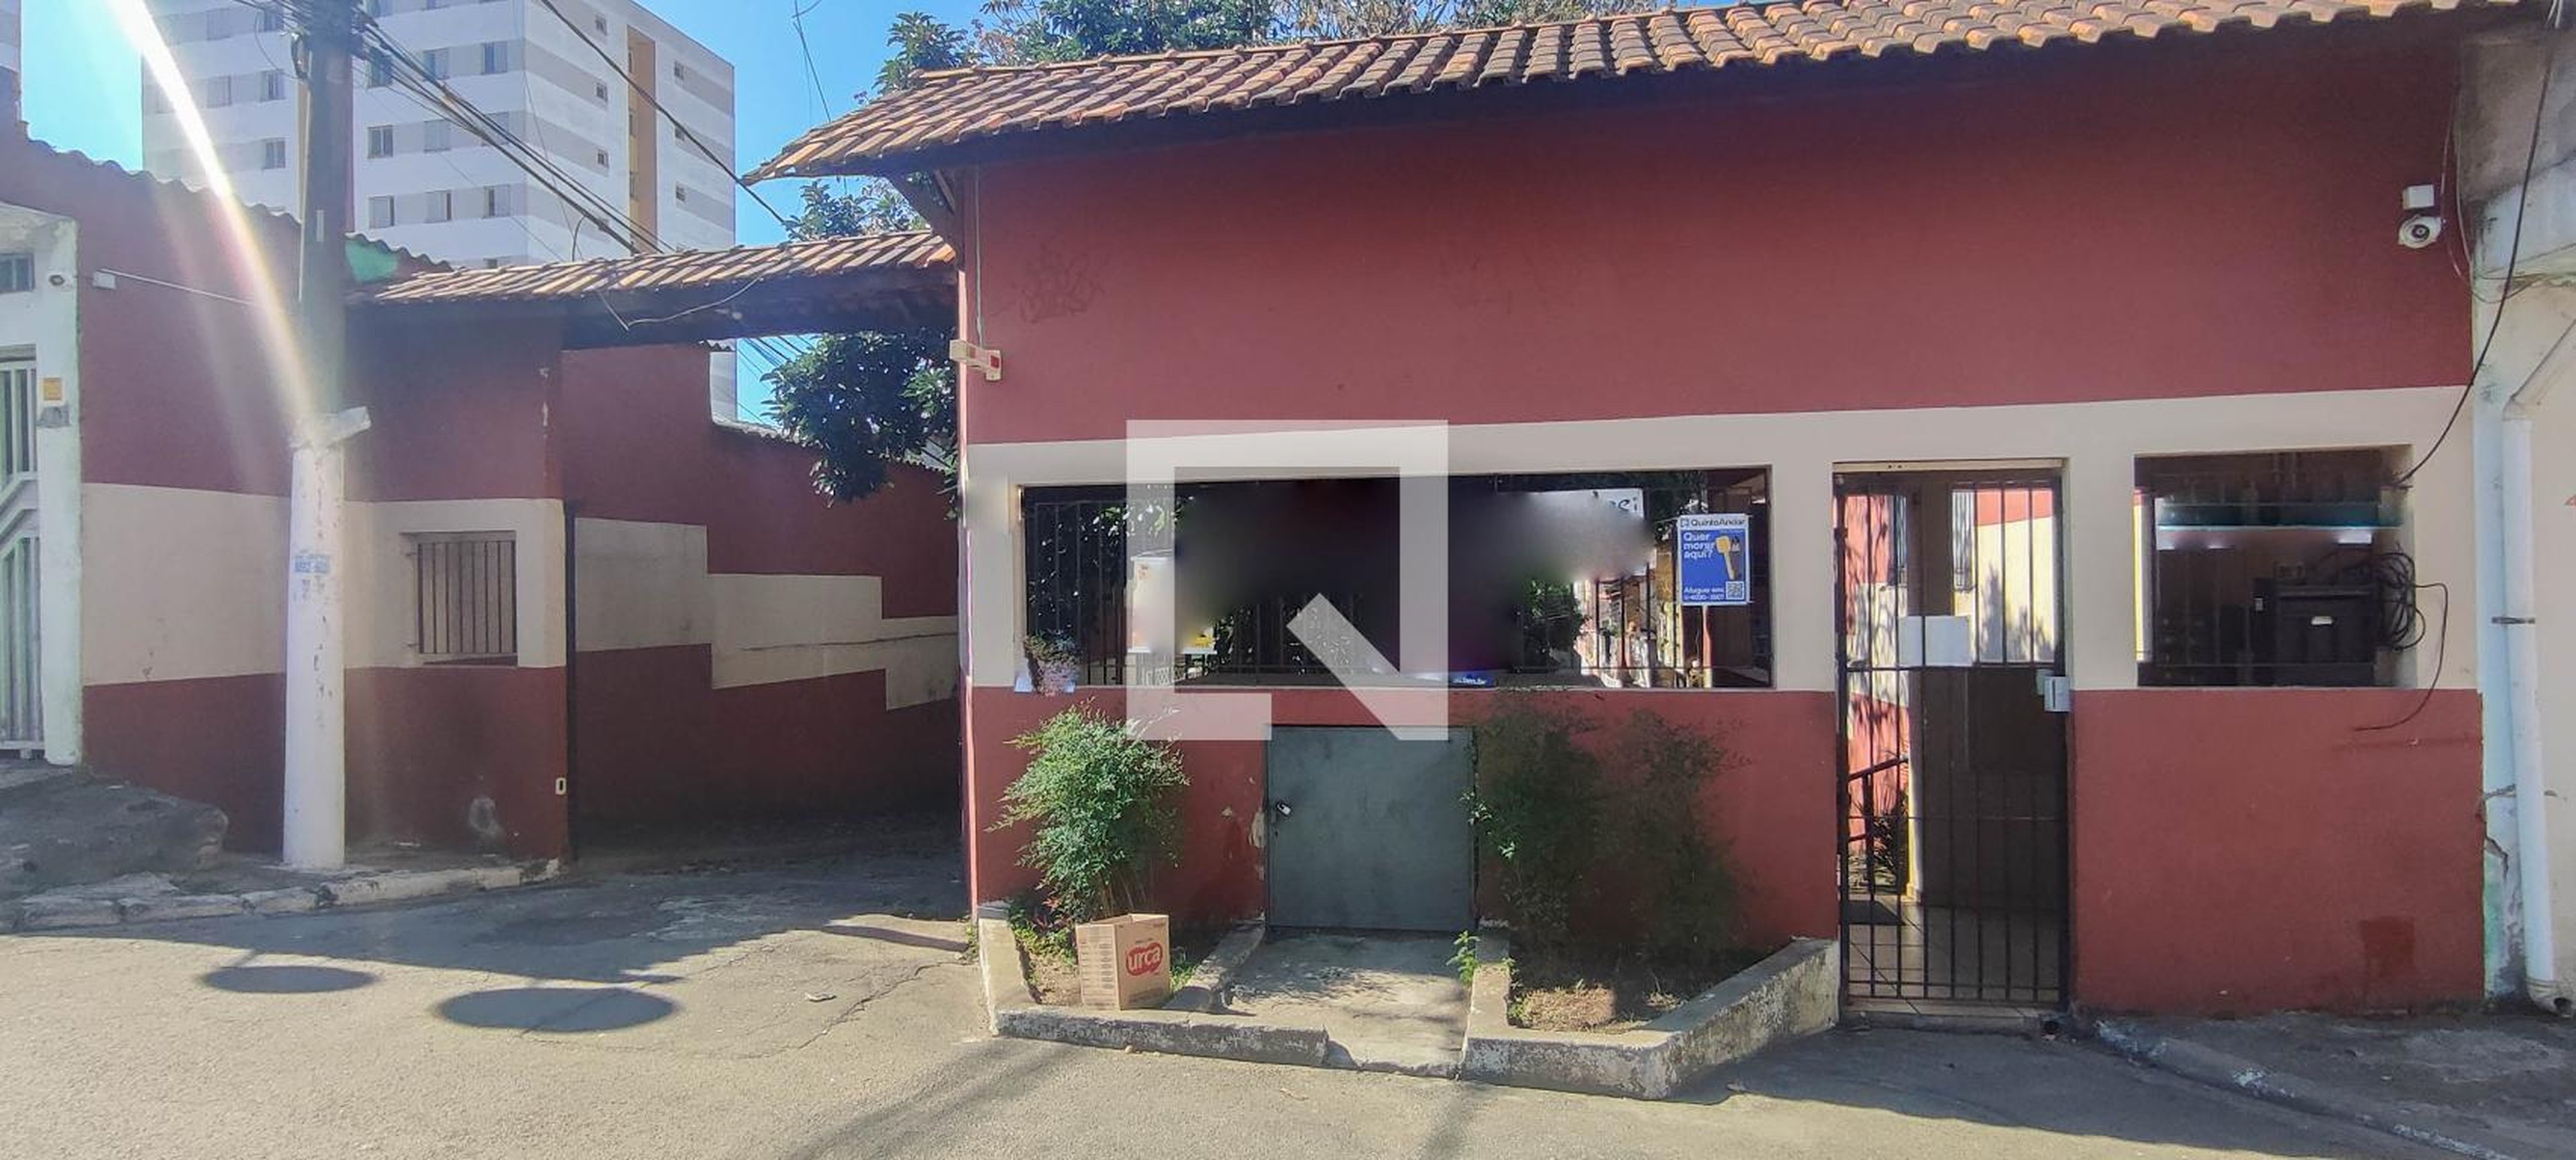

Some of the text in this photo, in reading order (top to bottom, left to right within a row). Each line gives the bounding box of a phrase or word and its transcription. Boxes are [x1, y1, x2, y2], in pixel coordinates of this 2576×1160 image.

[1690, 519, 1746, 527] QuintoAndar
[1683, 532, 1711, 541] Quer
[1683, 542, 1715, 550] morar
[1684, 549, 1713, 560] aqui?
[1127, 945, 1161, 972] urca
